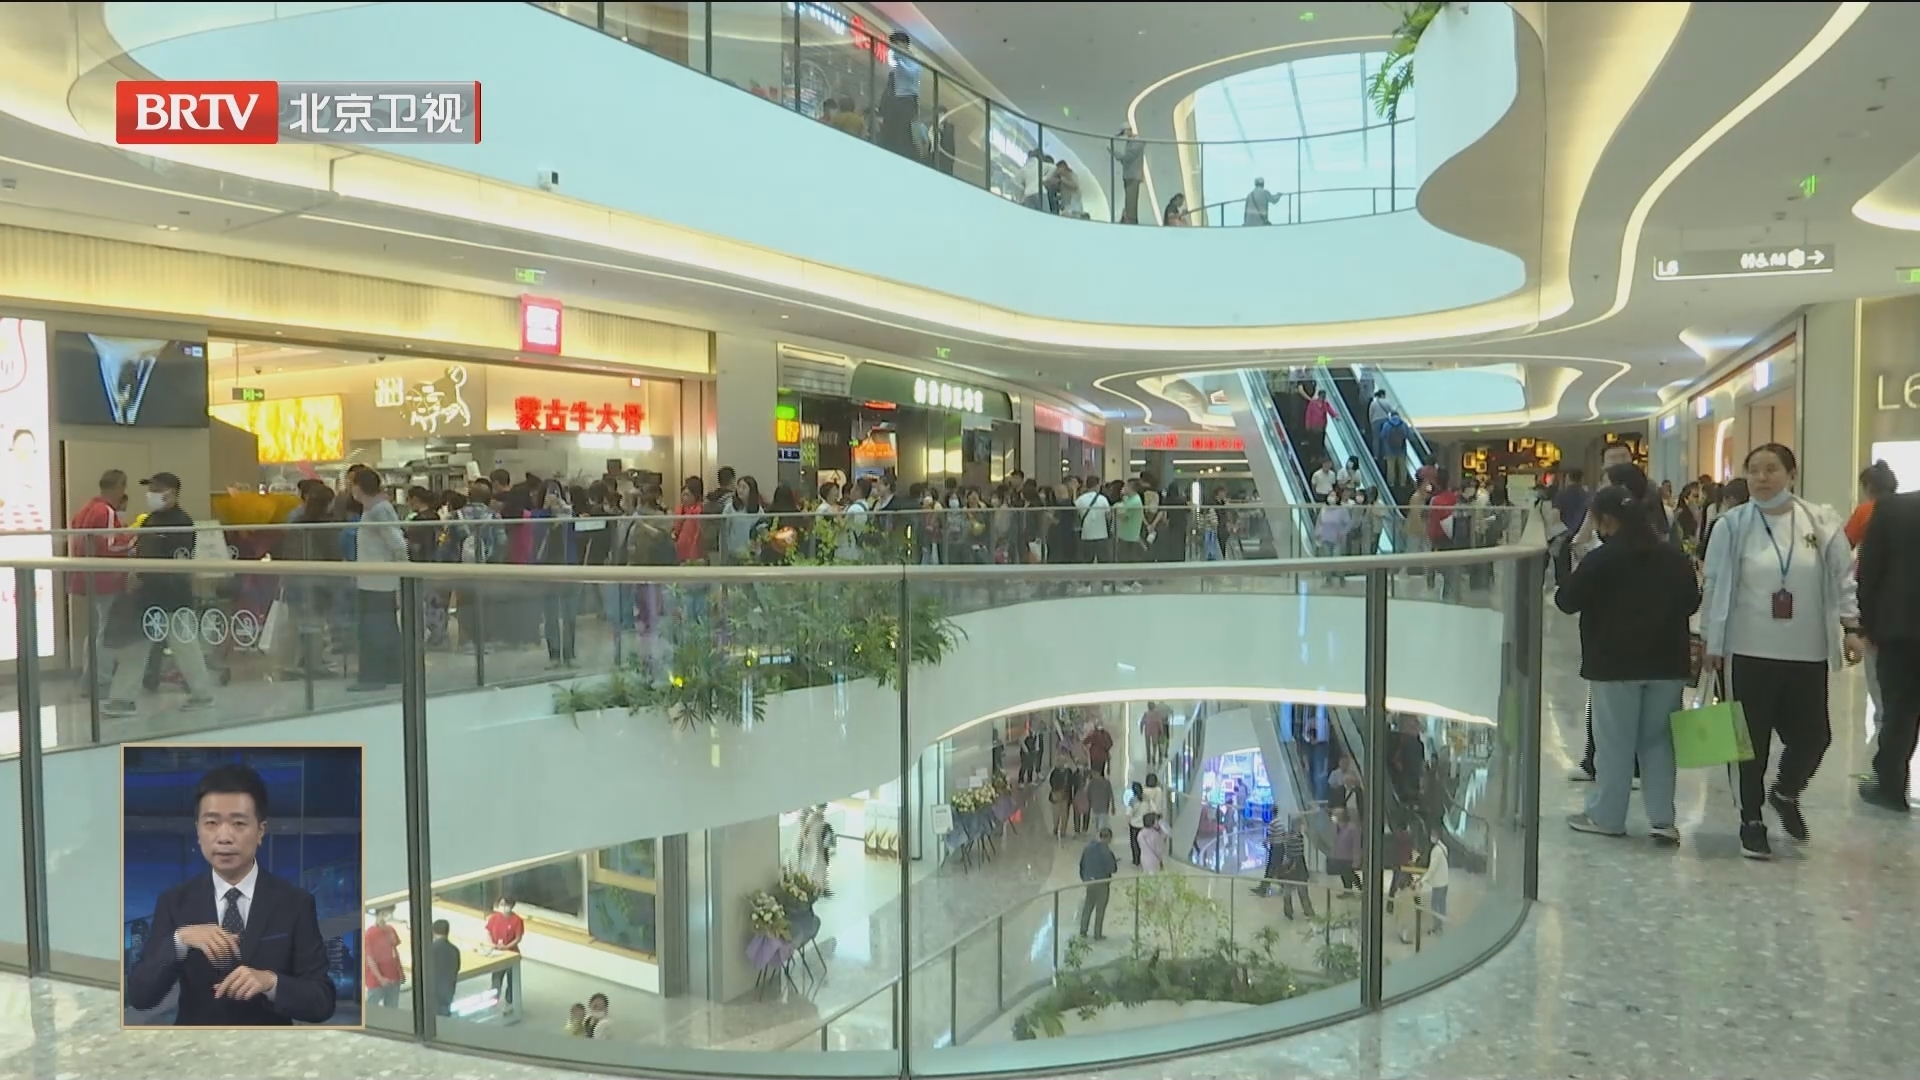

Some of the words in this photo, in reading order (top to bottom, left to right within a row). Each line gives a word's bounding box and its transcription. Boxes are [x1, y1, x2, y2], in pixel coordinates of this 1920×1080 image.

[514, 396, 645, 434] 蒙古牛大骨
